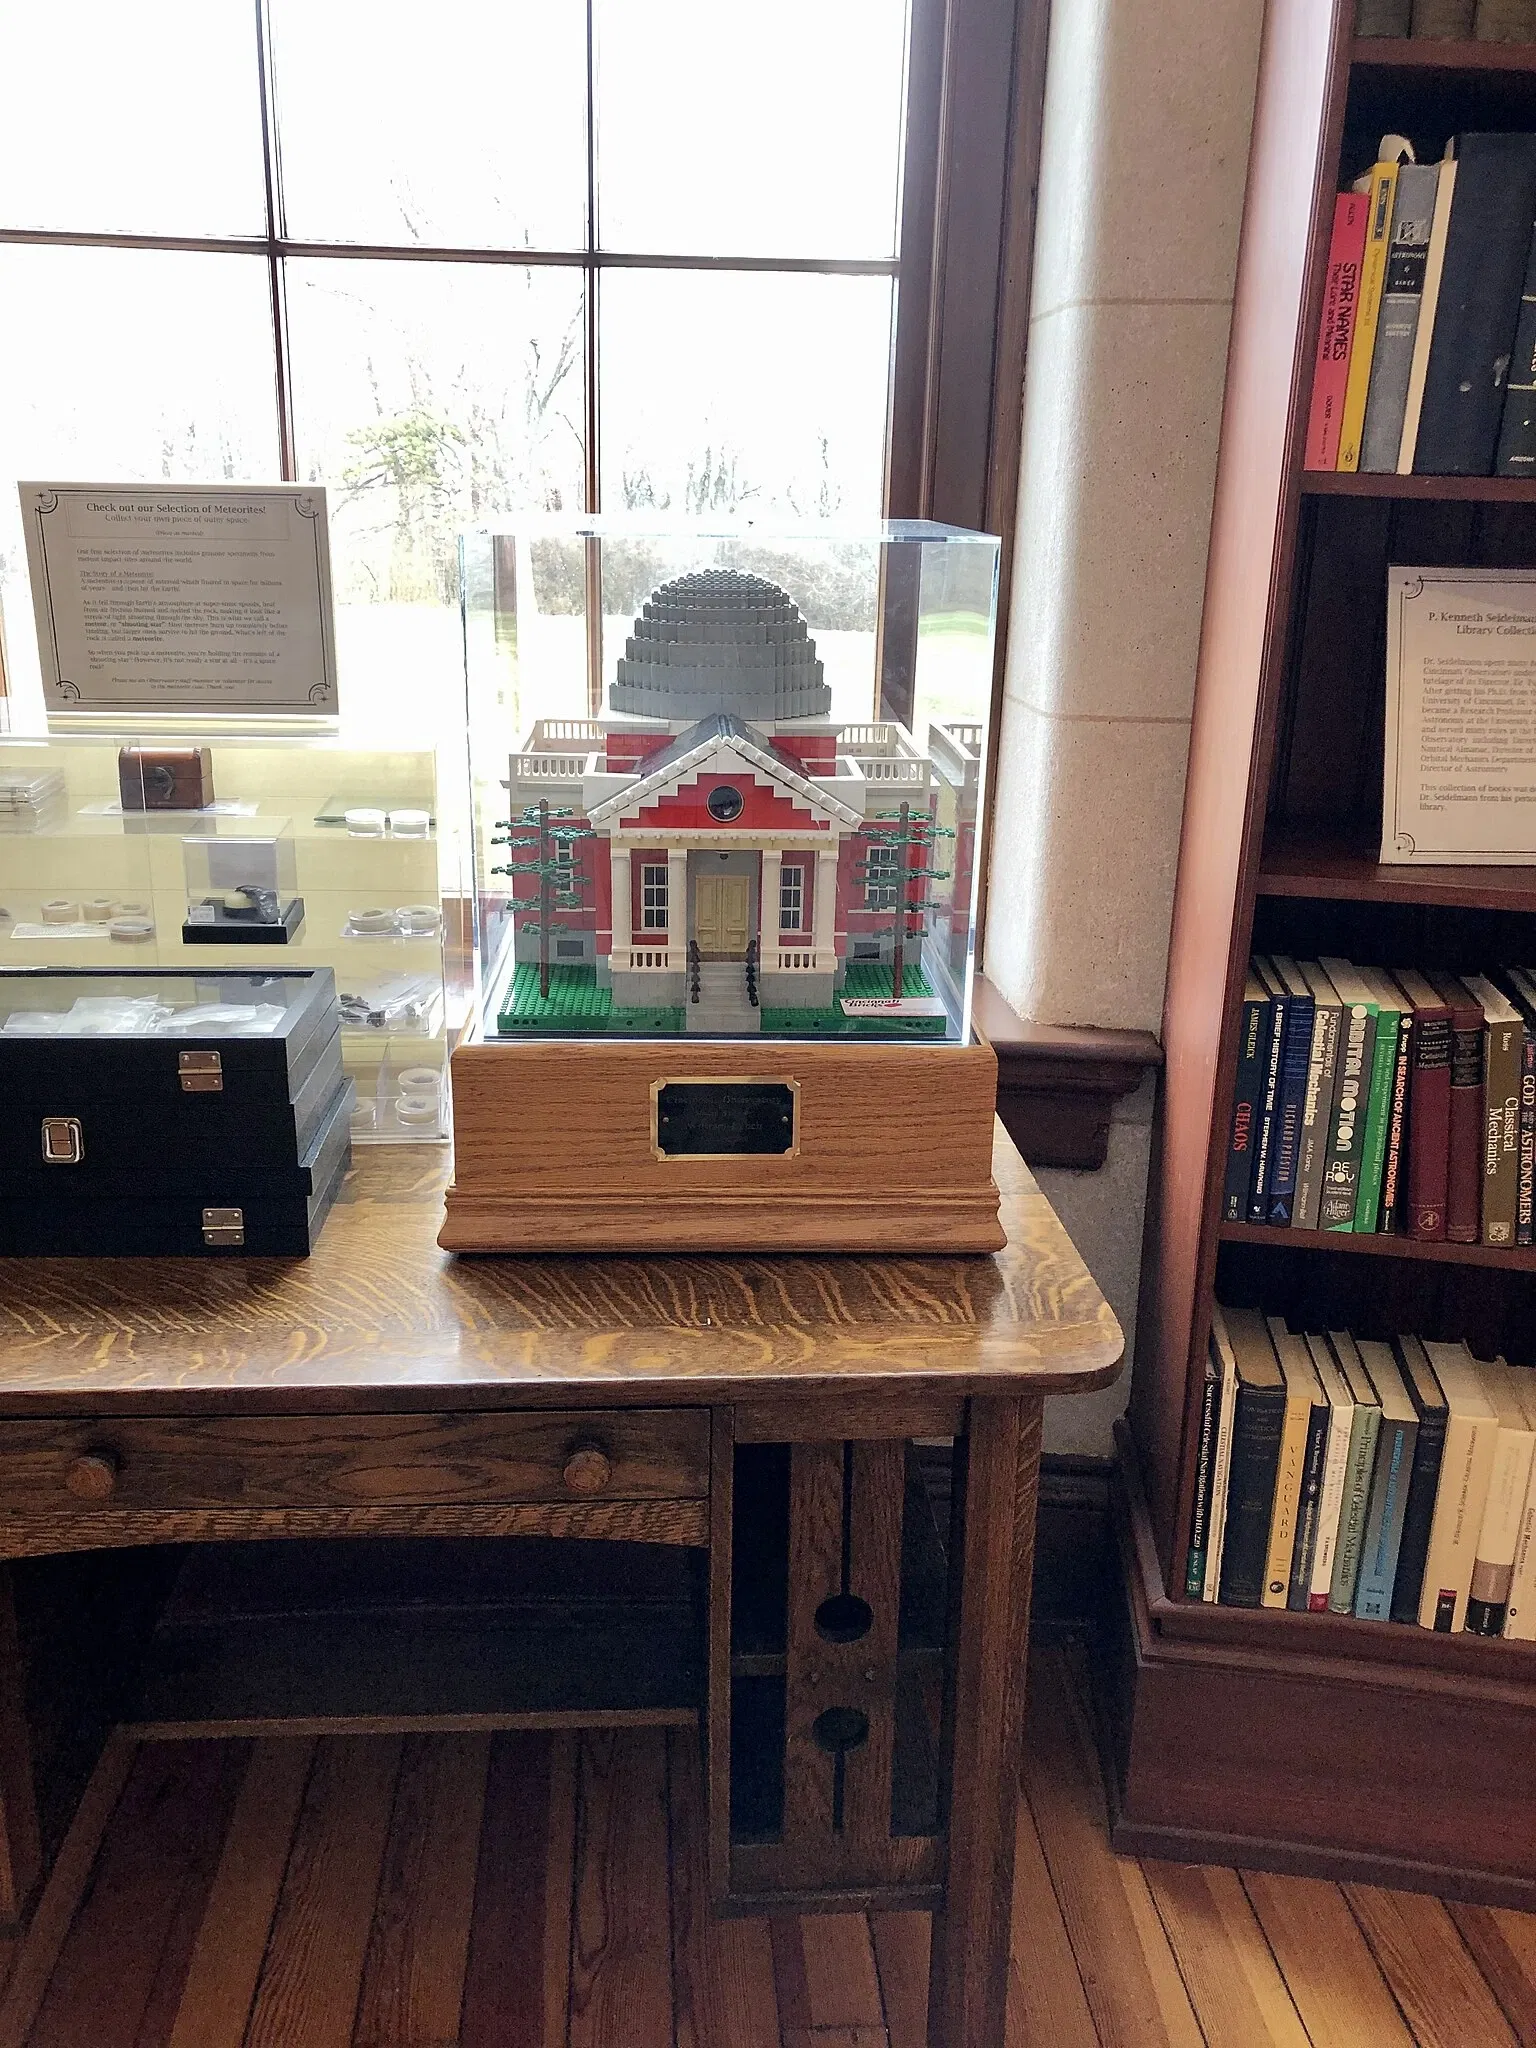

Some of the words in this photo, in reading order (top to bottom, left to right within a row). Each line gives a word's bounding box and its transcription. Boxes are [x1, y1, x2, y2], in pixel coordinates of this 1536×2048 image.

[1332, 263, 1341, 284] Their
[1340, 263, 1357, 302] STAR
[1327, 307, 1335, 324] and
[1333, 306, 1352, 361] NAMES
[86, 502, 116, 512] Check
[119, 504, 134, 512] out
[137, 505, 153, 513] our
[157, 503, 199, 513] Selection
[202, 505, 212, 513] of
[214, 505, 266, 515] Meteorites!
[105, 514, 132, 522] Collect
[134, 516, 151, 524] your
[172, 516, 192, 524] piece
[194, 515, 203, 523] of
[1441, 611, 1483, 622] Kenneth
[1456, 624, 1492, 635] Library
[1249, 1007, 1260, 1032] JAMES
[1274, 1012, 1283, 1038] BRIEF
[1312, 1010, 1330, 1061] Celestial
[1246, 1032, 1257, 1059] GLEICK
[1325, 1012, 1340, 1066] Fundamentals
[1344, 1005, 1368, 1077] ORBITAL
[1386, 1045, 1394, 1066] Theory
[1399, 1033, 1409, 1053] Krupp
[1269, 1038, 1280, 1077] HISTORY
[1324, 1068, 1332, 1078] of
[1399, 1056, 1408, 1065] IN
[1268, 1077, 1276, 1089] OF
[1303, 1063, 1324, 1126] Mechanics
[1381, 1080, 1389, 1117] experiment
[1395, 1065, 1407, 1100] SEARCH
[1522, 1074, 1536, 1106] GOD
[1265, 1089, 1275, 1111] TIME
[1336, 1079, 1360, 1152] MOTION
[1393, 1101, 1403, 1114] OF
[1233, 1102, 1252, 1151] CHAOS
[1261, 1116, 1271, 1150] STEPHEN
[1282, 1103, 1297, 1141] RICHARD
[1390, 1113, 1402, 1149] ANCIENT
[1503, 1096, 1519, 1152] Classical
[1260, 1150, 1267, 1160] W.
[1486, 1107, 1503, 1175] Mechanics
[1256, 1160, 1266, 1194] HAWKING
[1277, 1144, 1293, 1181] PRESTON
[1303, 1154, 1313, 1172] Danby
[1325, 1171, 1354, 1184] ROY
[1372, 1163, 1381, 1186] physics
[1385, 1149, 1399, 1208] ASTRONOMIES
[1518, 1129, 1534, 1225] ASTRONOMERS
[1204, 1384, 1214, 1428] Successful
[1200, 1428, 1210, 1461] Celestial
[1354, 1436, 1371, 1482] Principles
[1197, 1460, 1208, 1501] Navigation
[1352, 1482, 1365, 1493] of
[1196, 1501, 1204, 1519] with
[1347, 1492, 1363, 1534] Celestial
[1340, 1536, 1357, 1587] Mechanics
